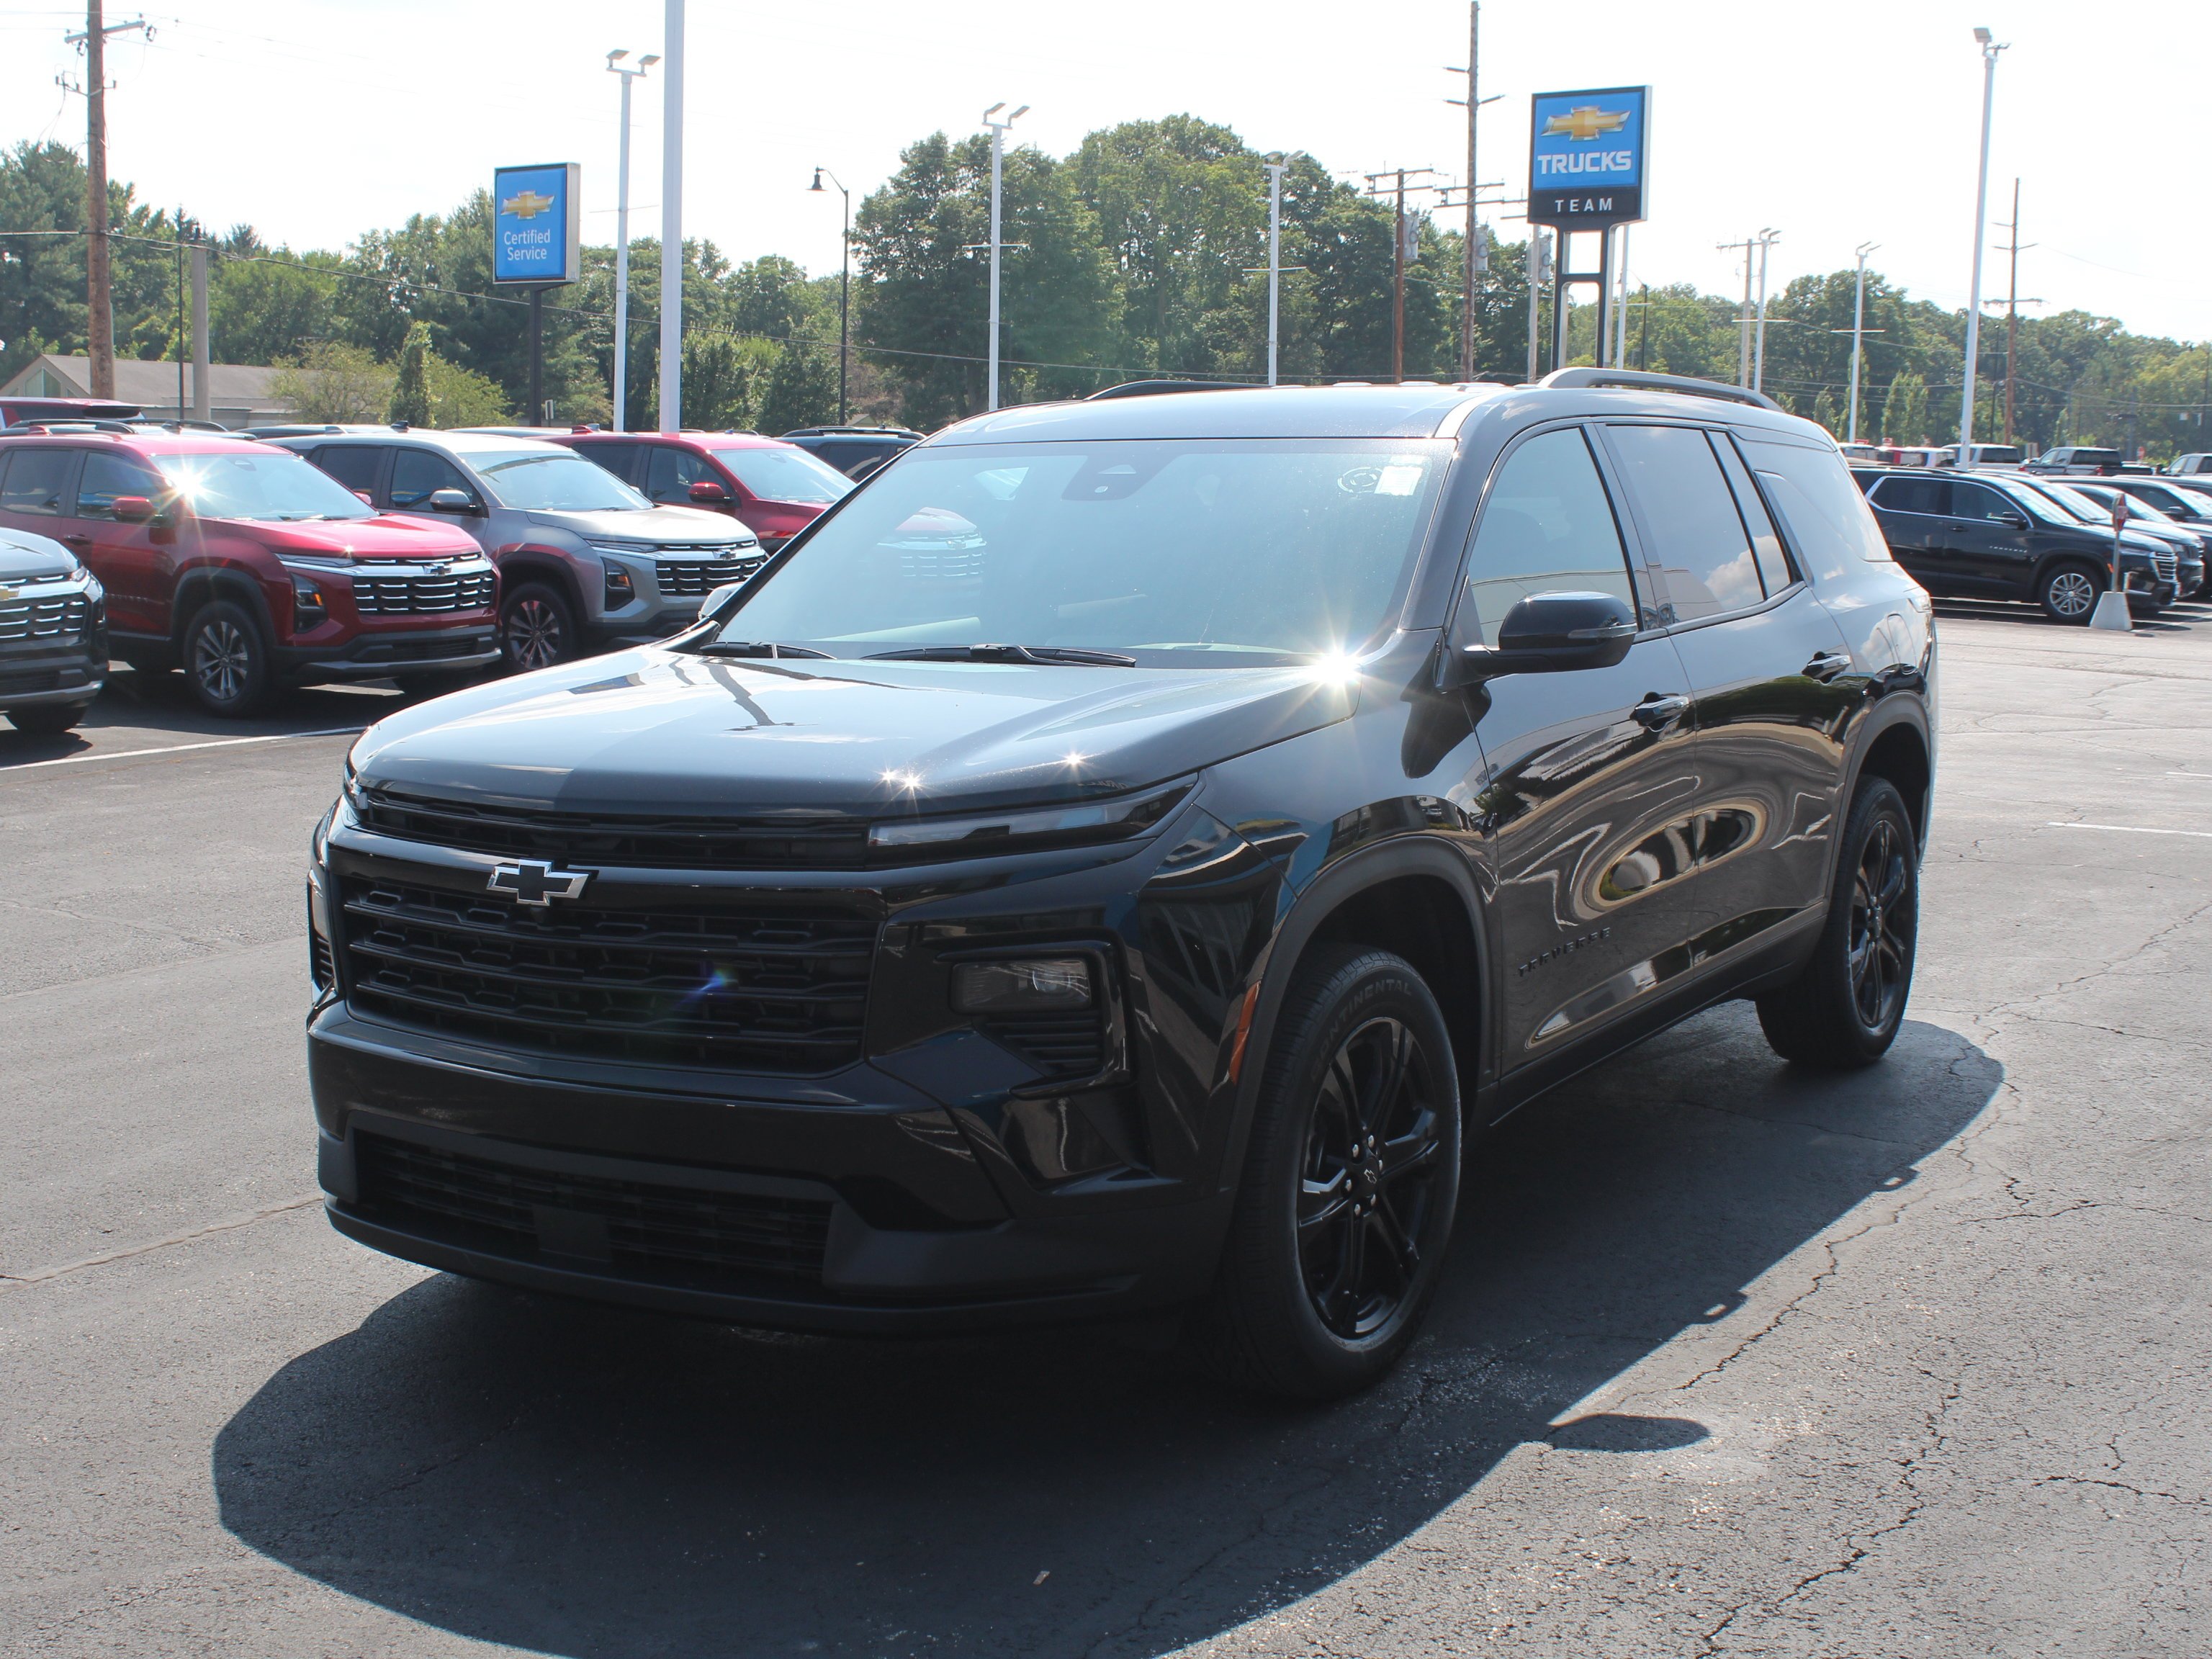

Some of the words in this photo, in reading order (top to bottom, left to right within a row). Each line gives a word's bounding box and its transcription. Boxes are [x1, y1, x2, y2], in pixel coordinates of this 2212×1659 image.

[1537, 150, 1632, 174] TRUCKS
[1555, 197, 1612, 212] TEAM
[504, 229, 551, 245] Certified
[507, 246, 547, 261] Service
